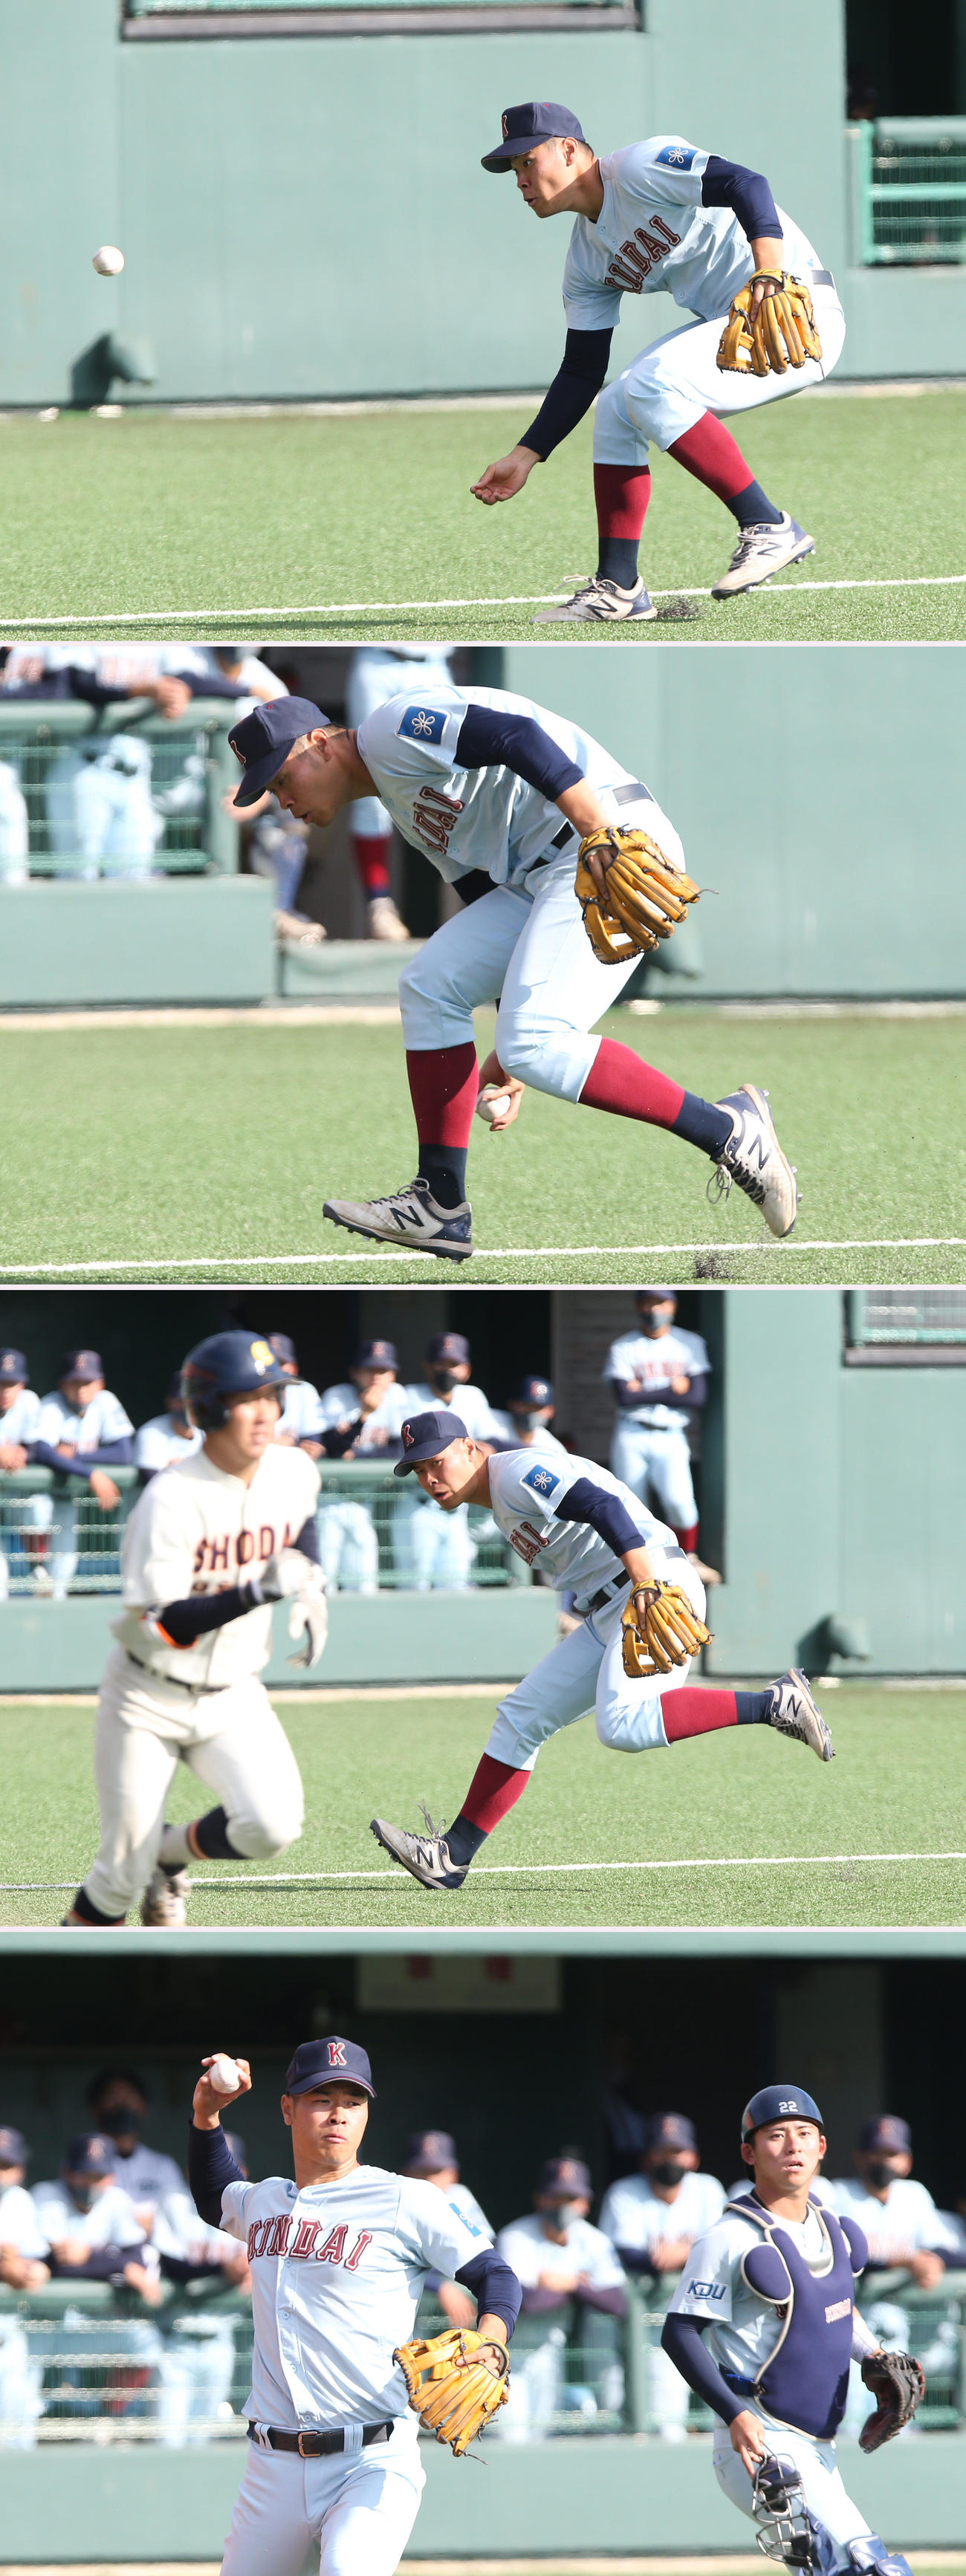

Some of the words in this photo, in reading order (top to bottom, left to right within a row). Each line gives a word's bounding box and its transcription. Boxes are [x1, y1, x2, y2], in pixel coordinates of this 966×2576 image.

[604, 215, 681, 294] INDAI
[389, 1205, 424, 1230] N
[402, 1424, 415, 1447] K
[327, 2043, 347, 2066] K
[779, 2100, 798, 2113] 22
[247, 2214, 372, 2271] KINDAI
[685, 2279, 727, 2300] KDU
